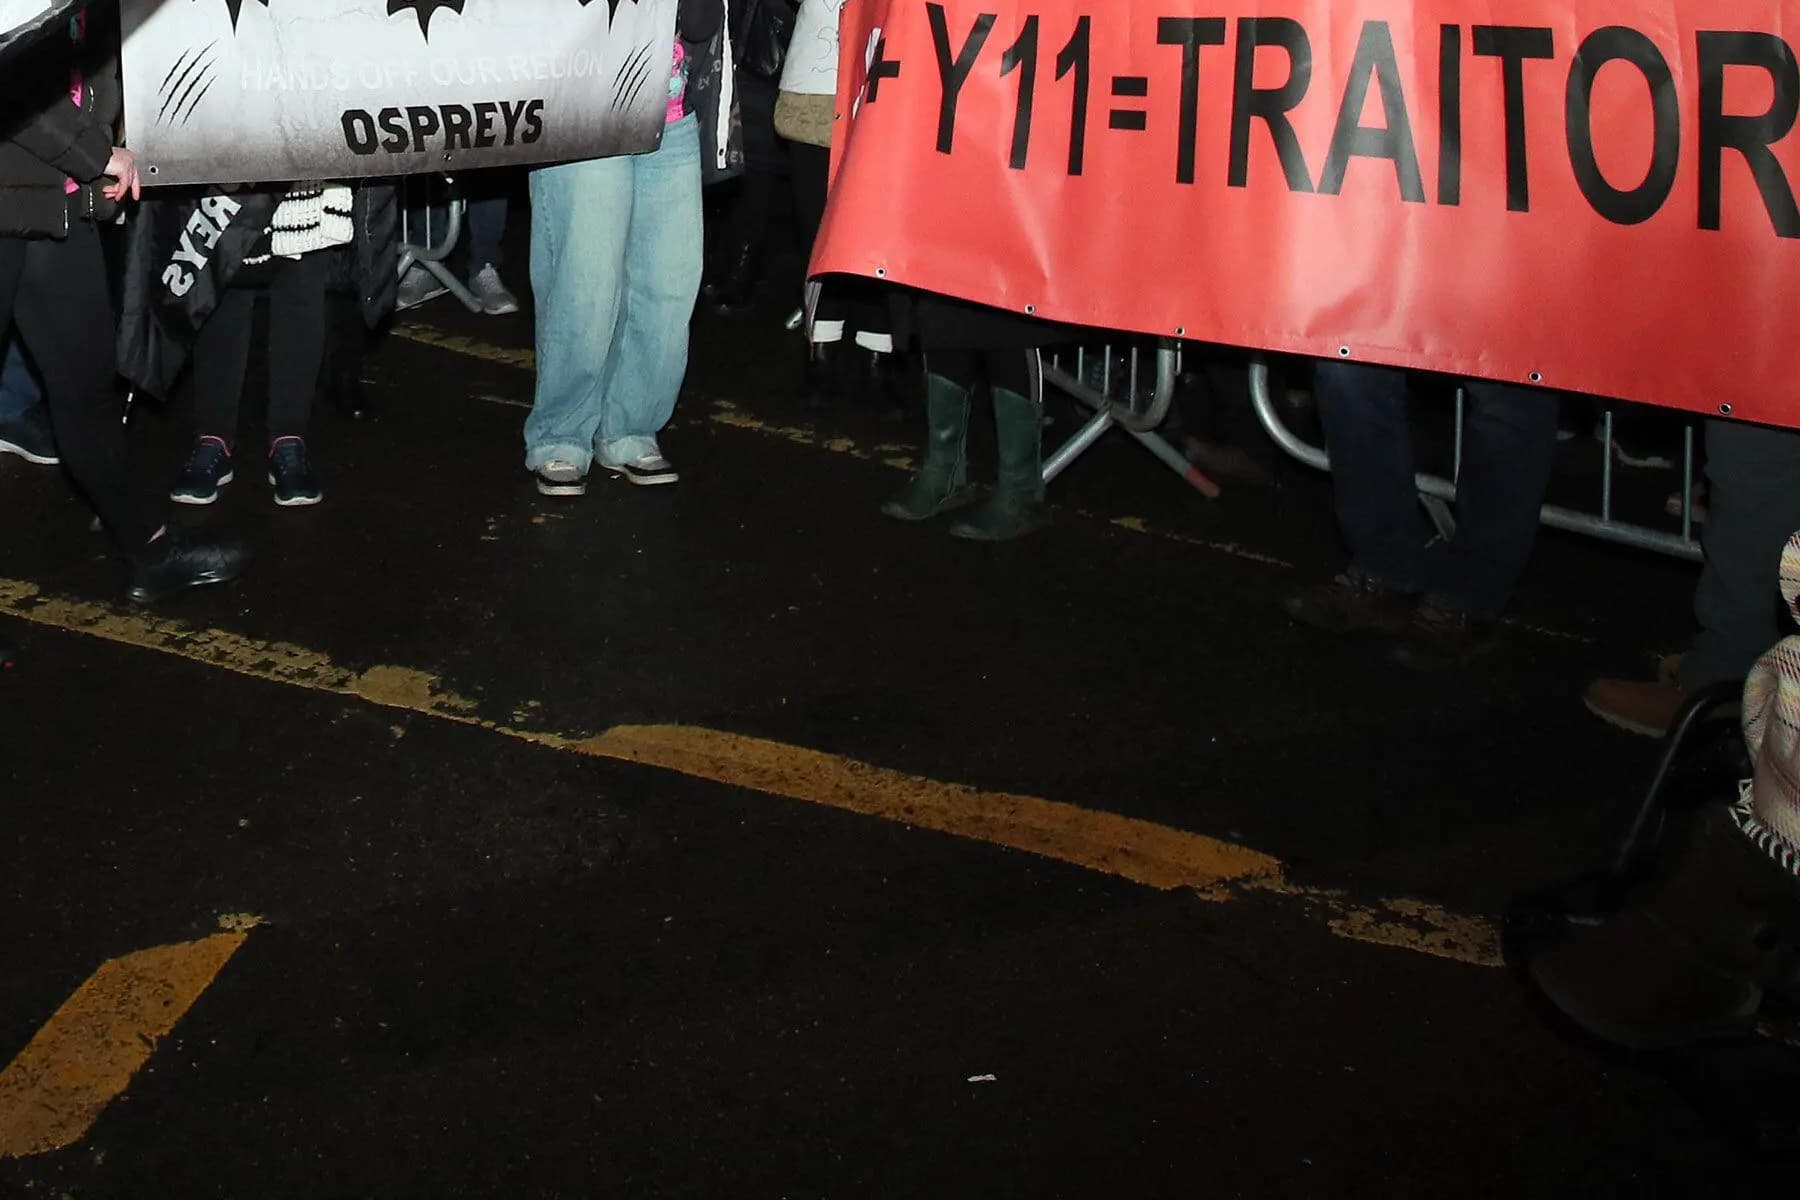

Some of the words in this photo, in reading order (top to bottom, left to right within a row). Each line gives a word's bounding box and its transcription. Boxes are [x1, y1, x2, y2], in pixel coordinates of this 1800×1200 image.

[241, 54, 352, 92] HANDS
[358, 61, 418, 91] OFF
[341, 99, 544, 156] OSPREYS
